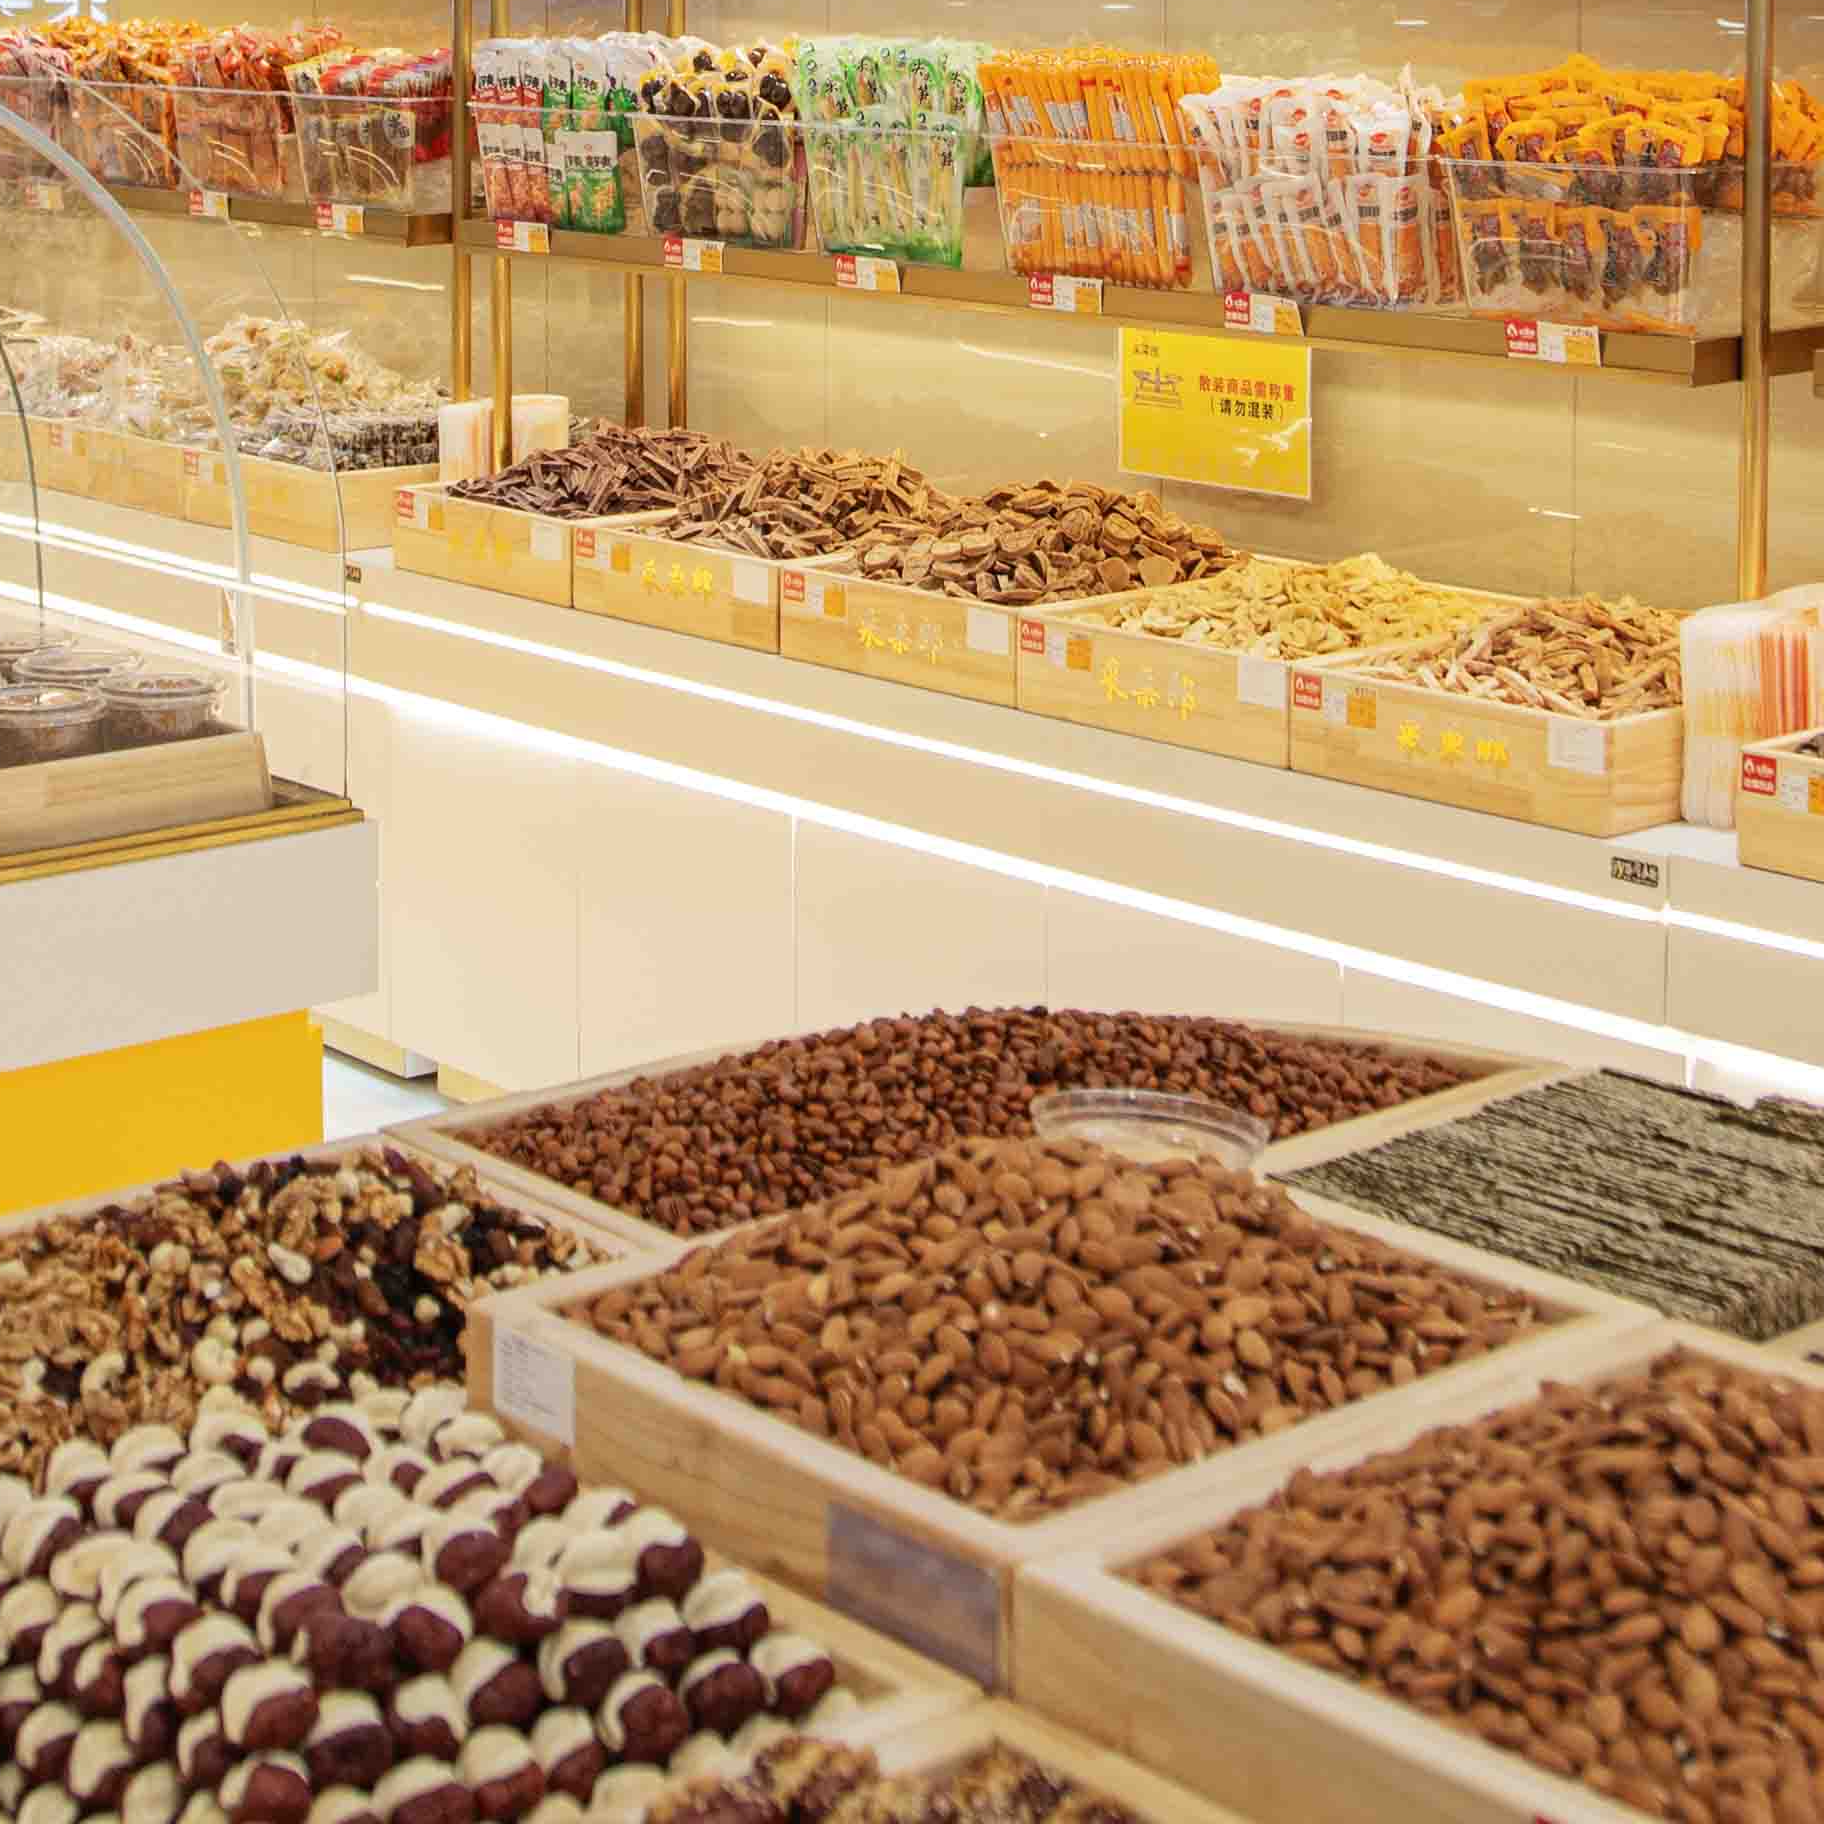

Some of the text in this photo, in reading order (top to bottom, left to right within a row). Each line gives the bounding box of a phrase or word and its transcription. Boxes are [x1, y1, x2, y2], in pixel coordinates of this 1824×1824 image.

[1200, 375, 1294, 401] 散装商品需称重
